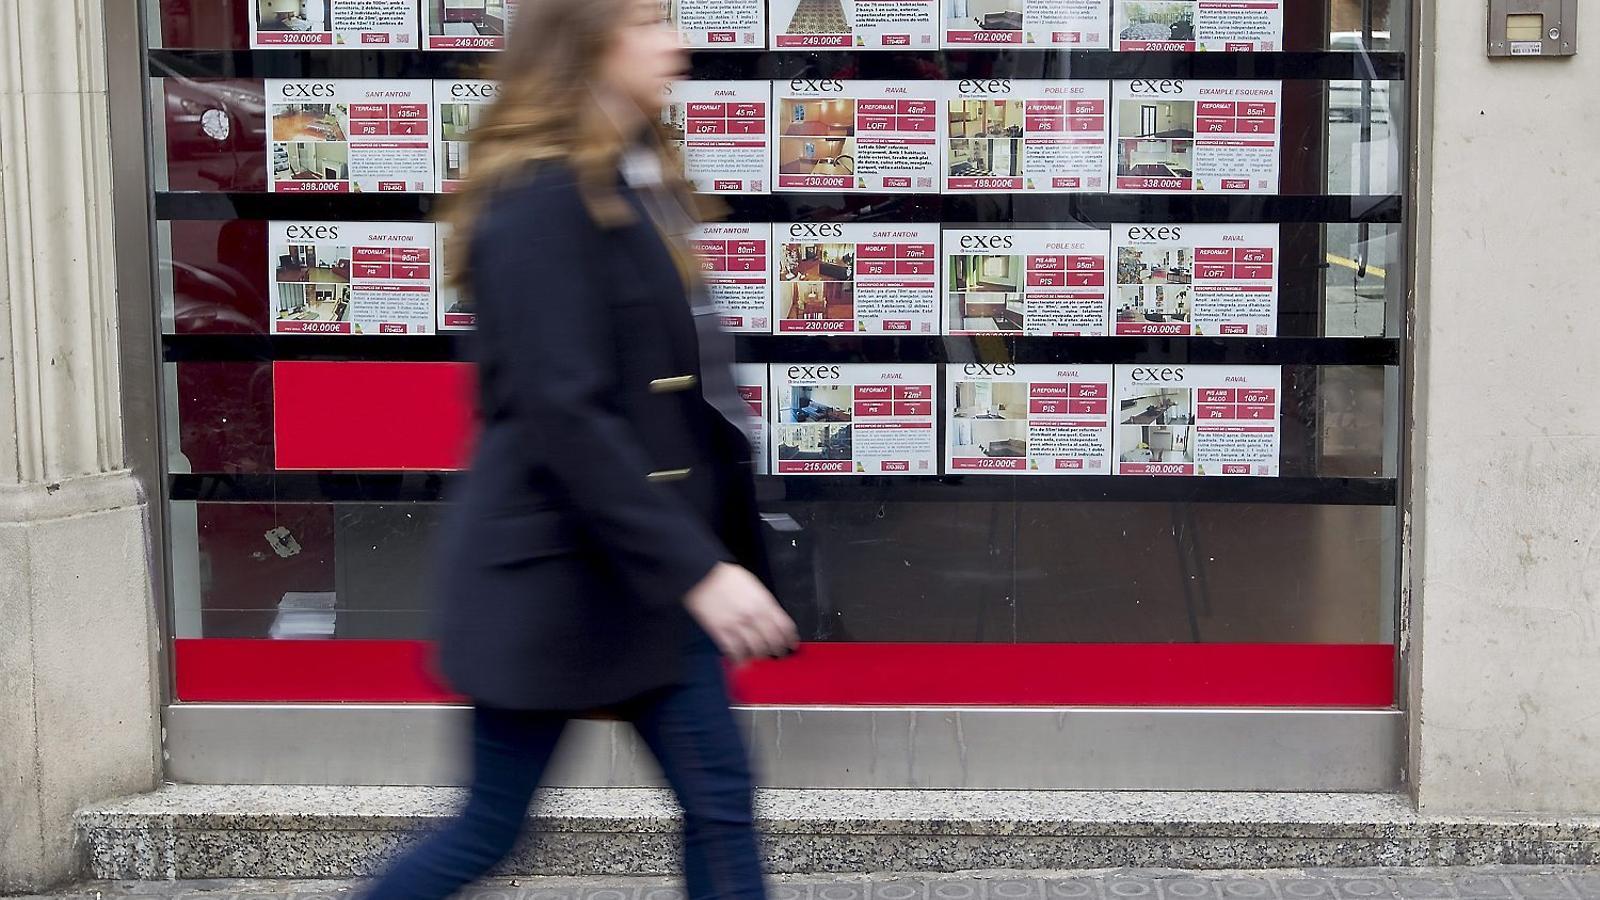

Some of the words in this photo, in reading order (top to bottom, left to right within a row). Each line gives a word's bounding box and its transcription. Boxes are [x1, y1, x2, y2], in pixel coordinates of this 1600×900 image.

[283, 34, 321, 43] 320.000€
[974, 33, 1013, 41] 102.000€
[455, 38, 494, 47] 249.000€
[1146, 43, 1185, 51] 230.000€
[283, 83, 335, 97] exes
[791, 79, 843, 92] exes
[959, 79, 1011, 93] exes
[1130, 79, 1184, 94] exes
[805, 178, 844, 186] 130.000€
[1143, 179, 1182, 188] 338.000€
[286, 225, 338, 239] exes
[790, 223, 843, 237] exes
[1128, 226, 1181, 240] exes
[960, 235, 1013, 249] exes
[302, 323, 340, 332] 340.000€
[805, 322, 844, 330] 230.000€
[1142, 325, 1181, 334] 190.000€
[787, 365, 840, 379] exes
[963, 363, 1016, 376] exes
[1131, 367, 1184, 381] exes
[804, 463, 843, 471] 215.000€
[978, 460, 1017, 468] 102.000€
[1145, 465, 1184, 473] 280.000€
